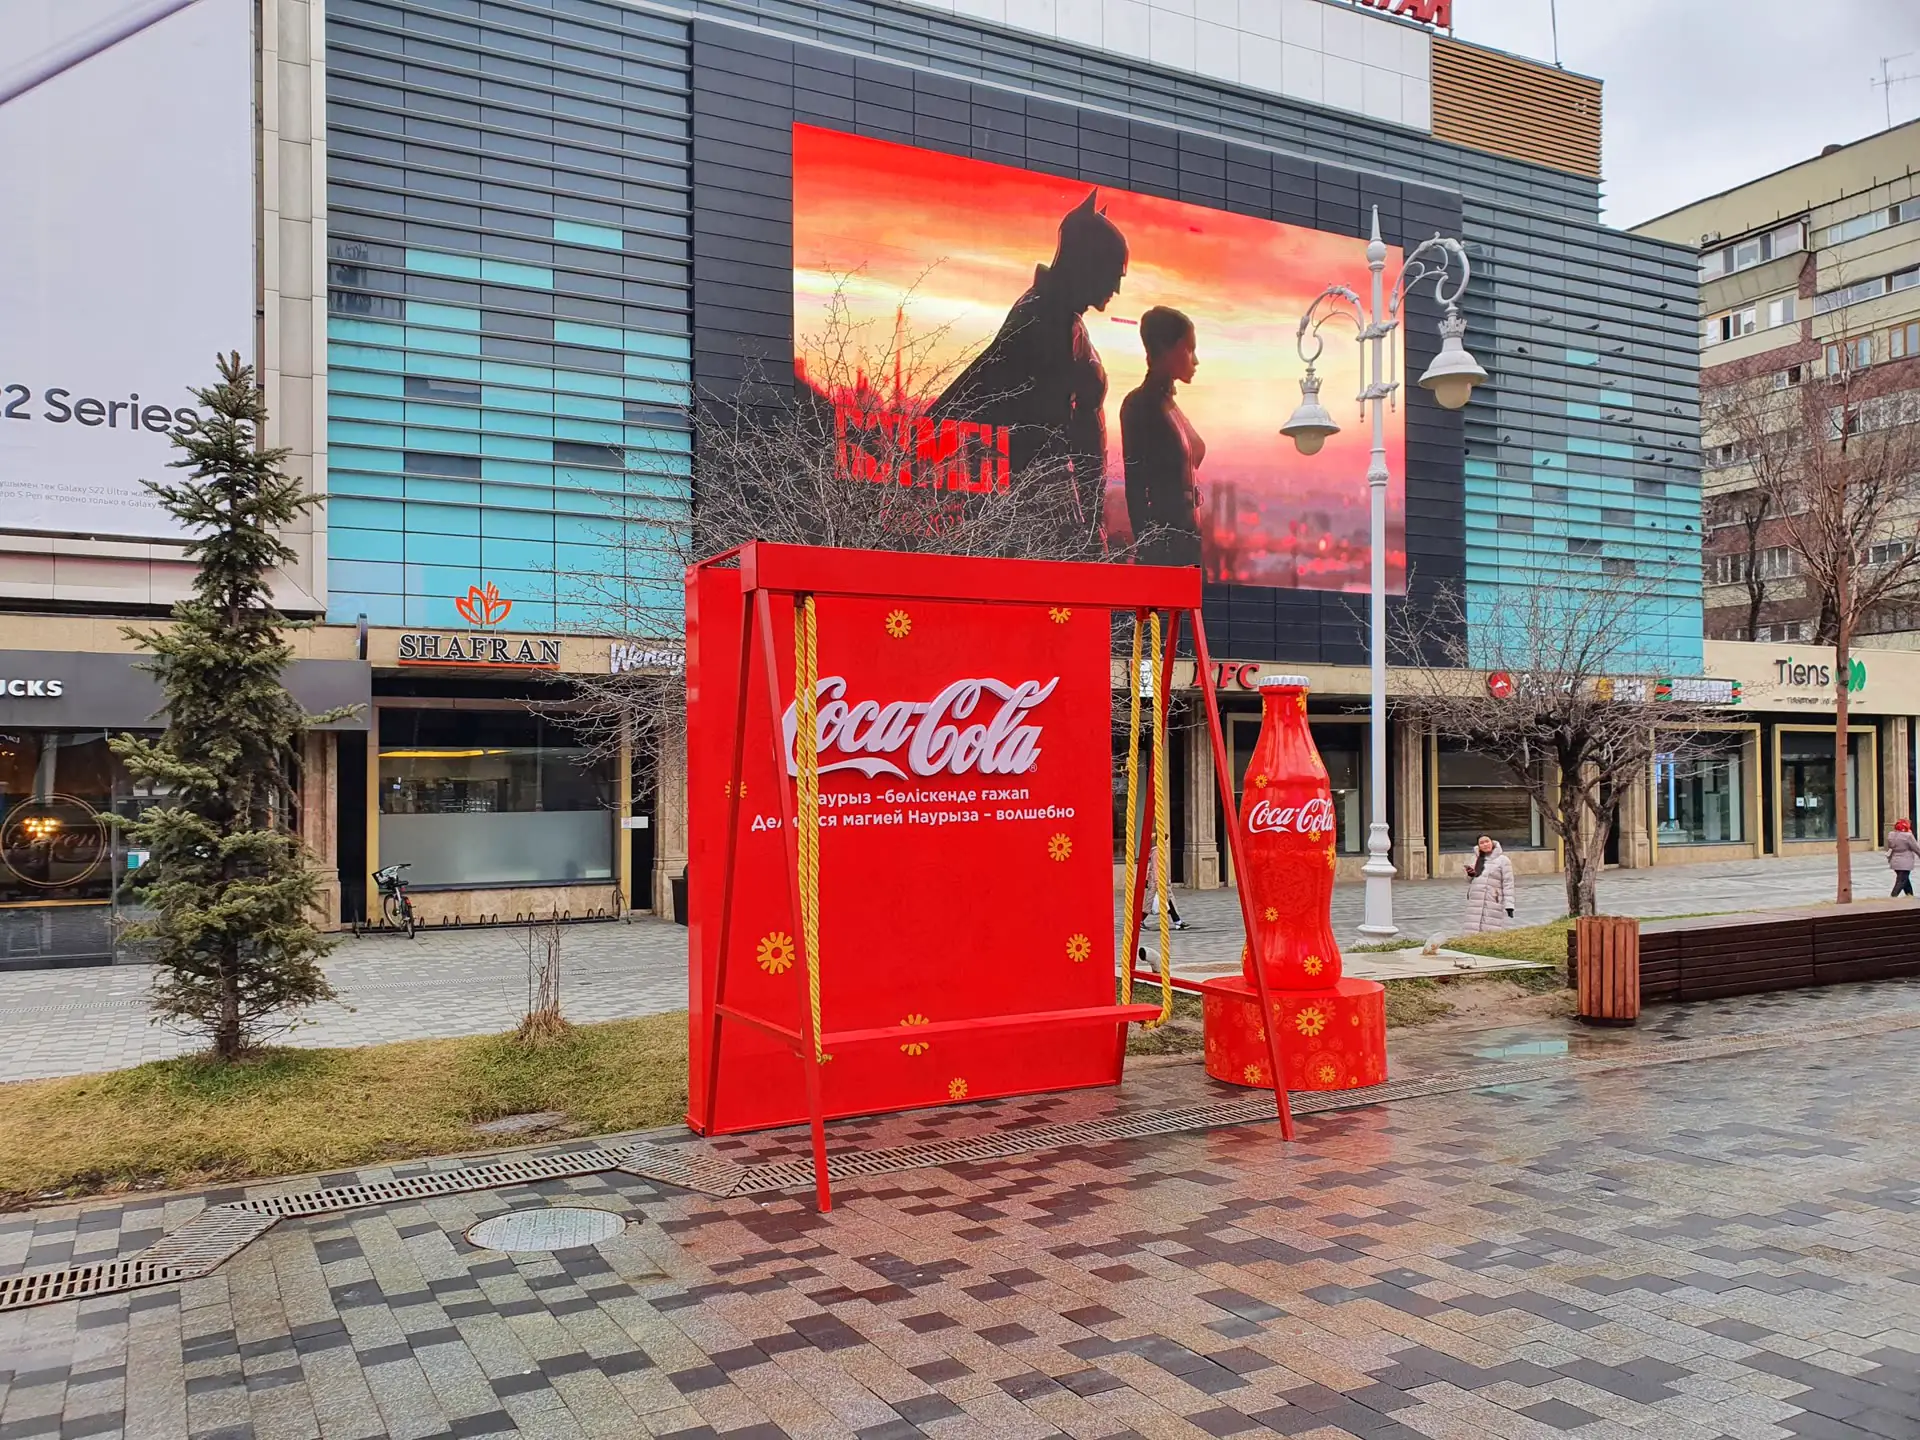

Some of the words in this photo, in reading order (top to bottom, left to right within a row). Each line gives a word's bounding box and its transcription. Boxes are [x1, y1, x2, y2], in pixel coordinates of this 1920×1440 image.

[0, 383, 31, 420] 2
[43, 387, 199, 435] Series
[399, 633, 562, 663] SHAFRAN
[1775, 656, 1830, 687] Tiens
[781, 676, 1060, 781] Coca-Cola
[981, 788, 1029, 802] ғажап
[843, 809, 904, 826] магией
[908, 809, 979, 826] Наурыза
[996, 805, 1075, 821] волшебно
[1248, 798, 1334, 834] Coca-Cola
